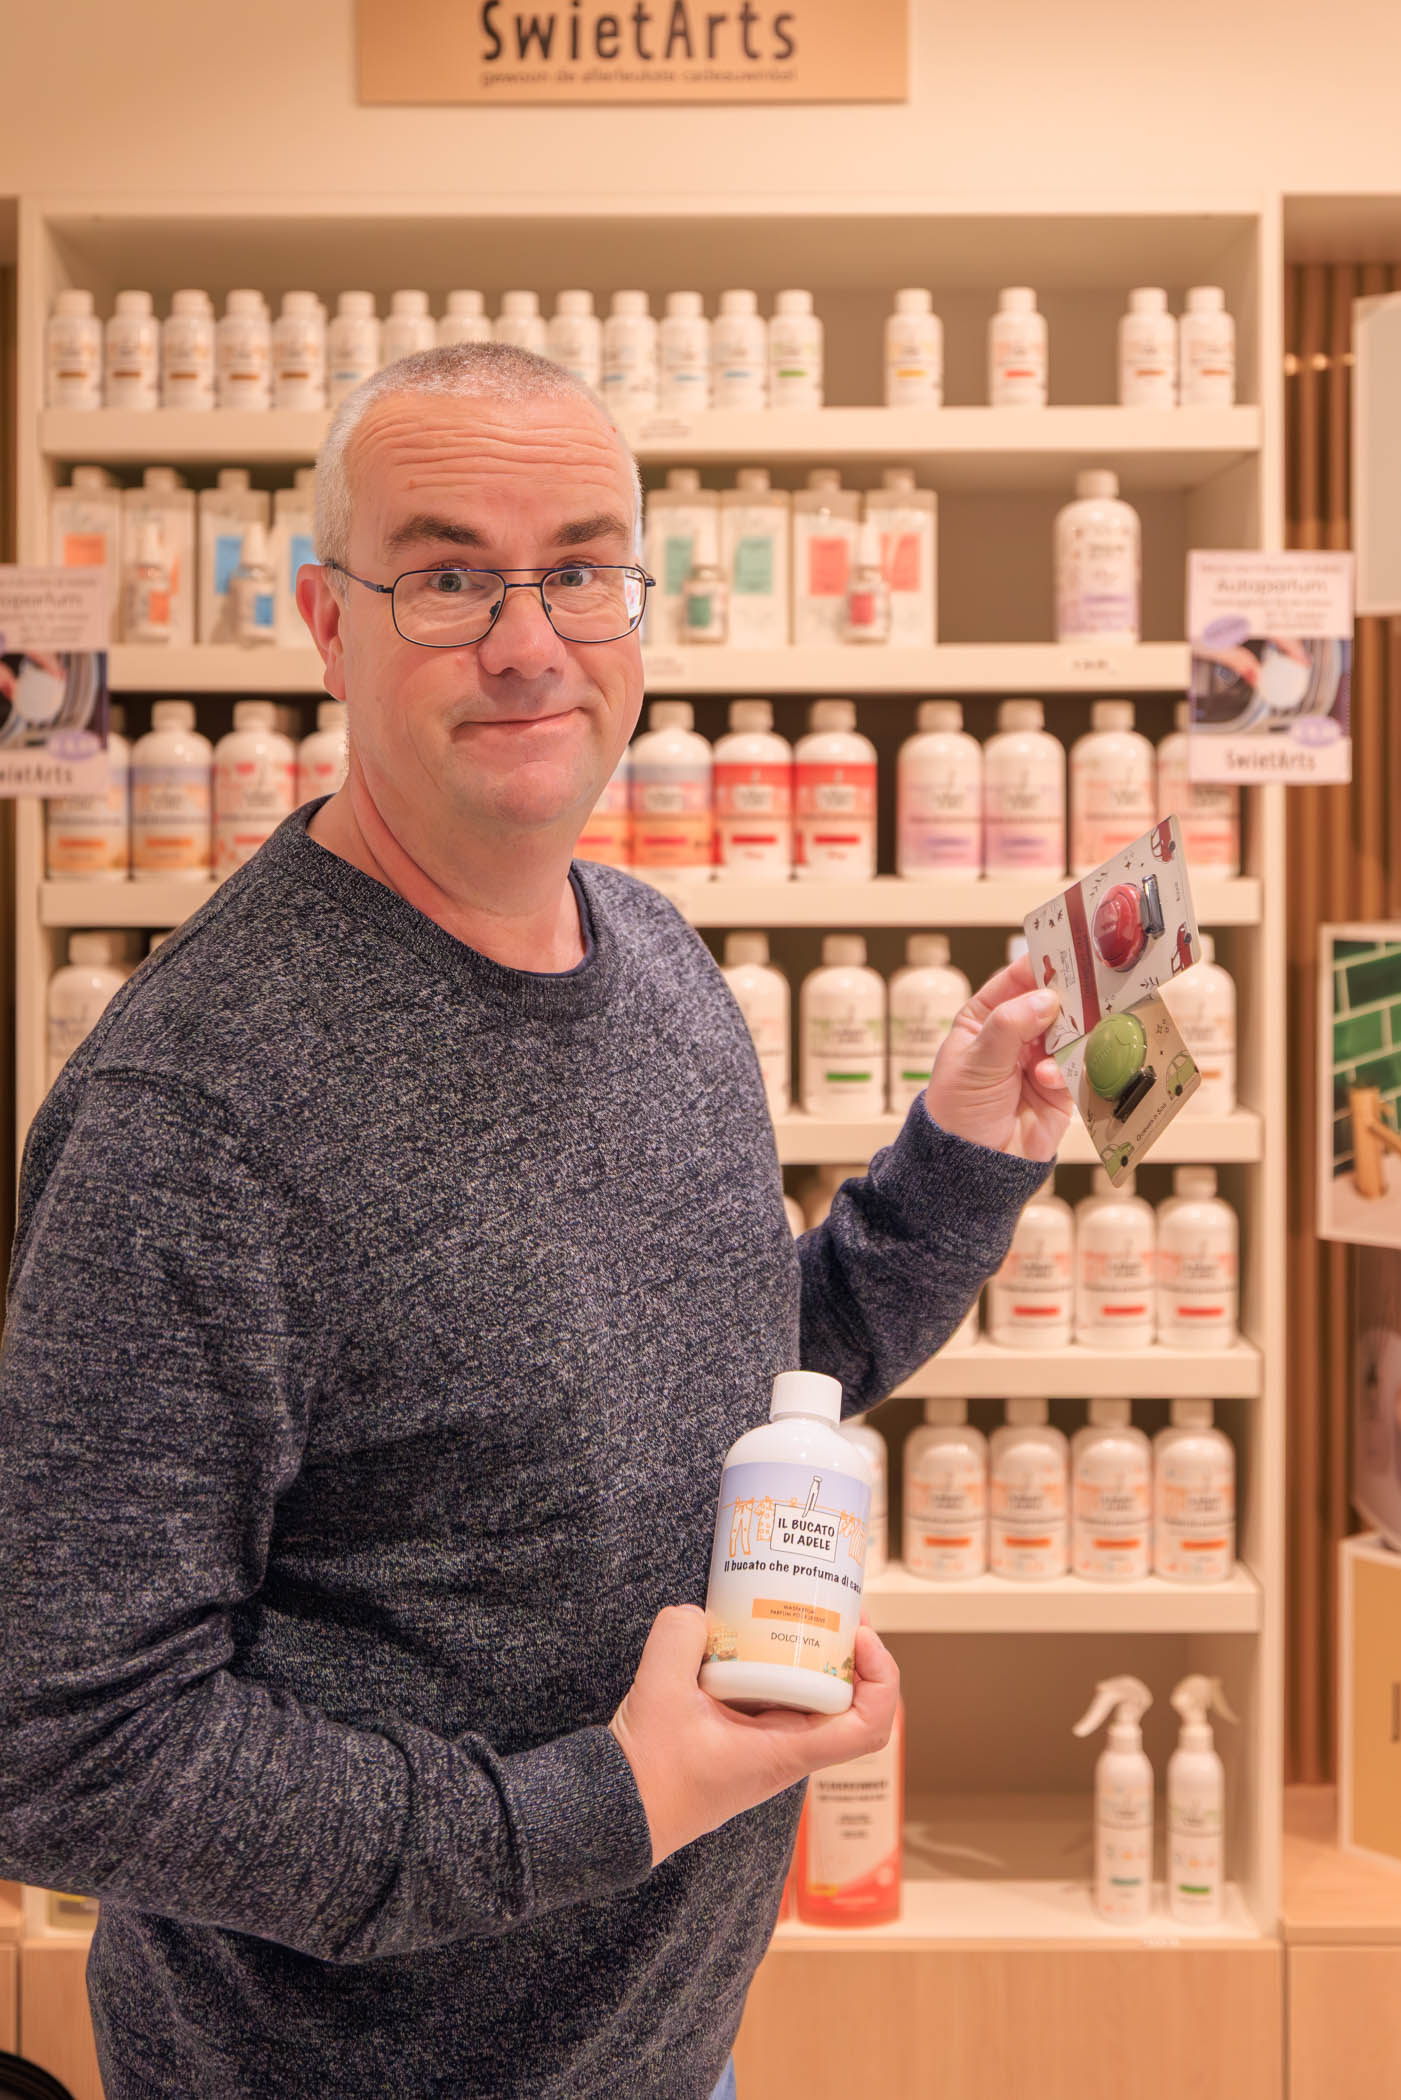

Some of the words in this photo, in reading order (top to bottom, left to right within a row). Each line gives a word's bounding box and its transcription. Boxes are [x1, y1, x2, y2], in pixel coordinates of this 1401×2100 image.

[481, 0, 796, 61] SwietArts
[1226, 751, 1317, 772] SwietArts
[778, 1517, 788, 1529] IL
[791, 1519, 835, 1537] BUCATO
[783, 1532, 794, 1544] DI
[796, 1535, 831, 1551] ADELE
[731, 1560, 766, 1571] bucato
[769, 1560, 789, 1572] che
[792, 1565, 840, 1583] profuma
[841, 1575, 849, 1588] di
[803, 1637, 820, 1648] VITA
